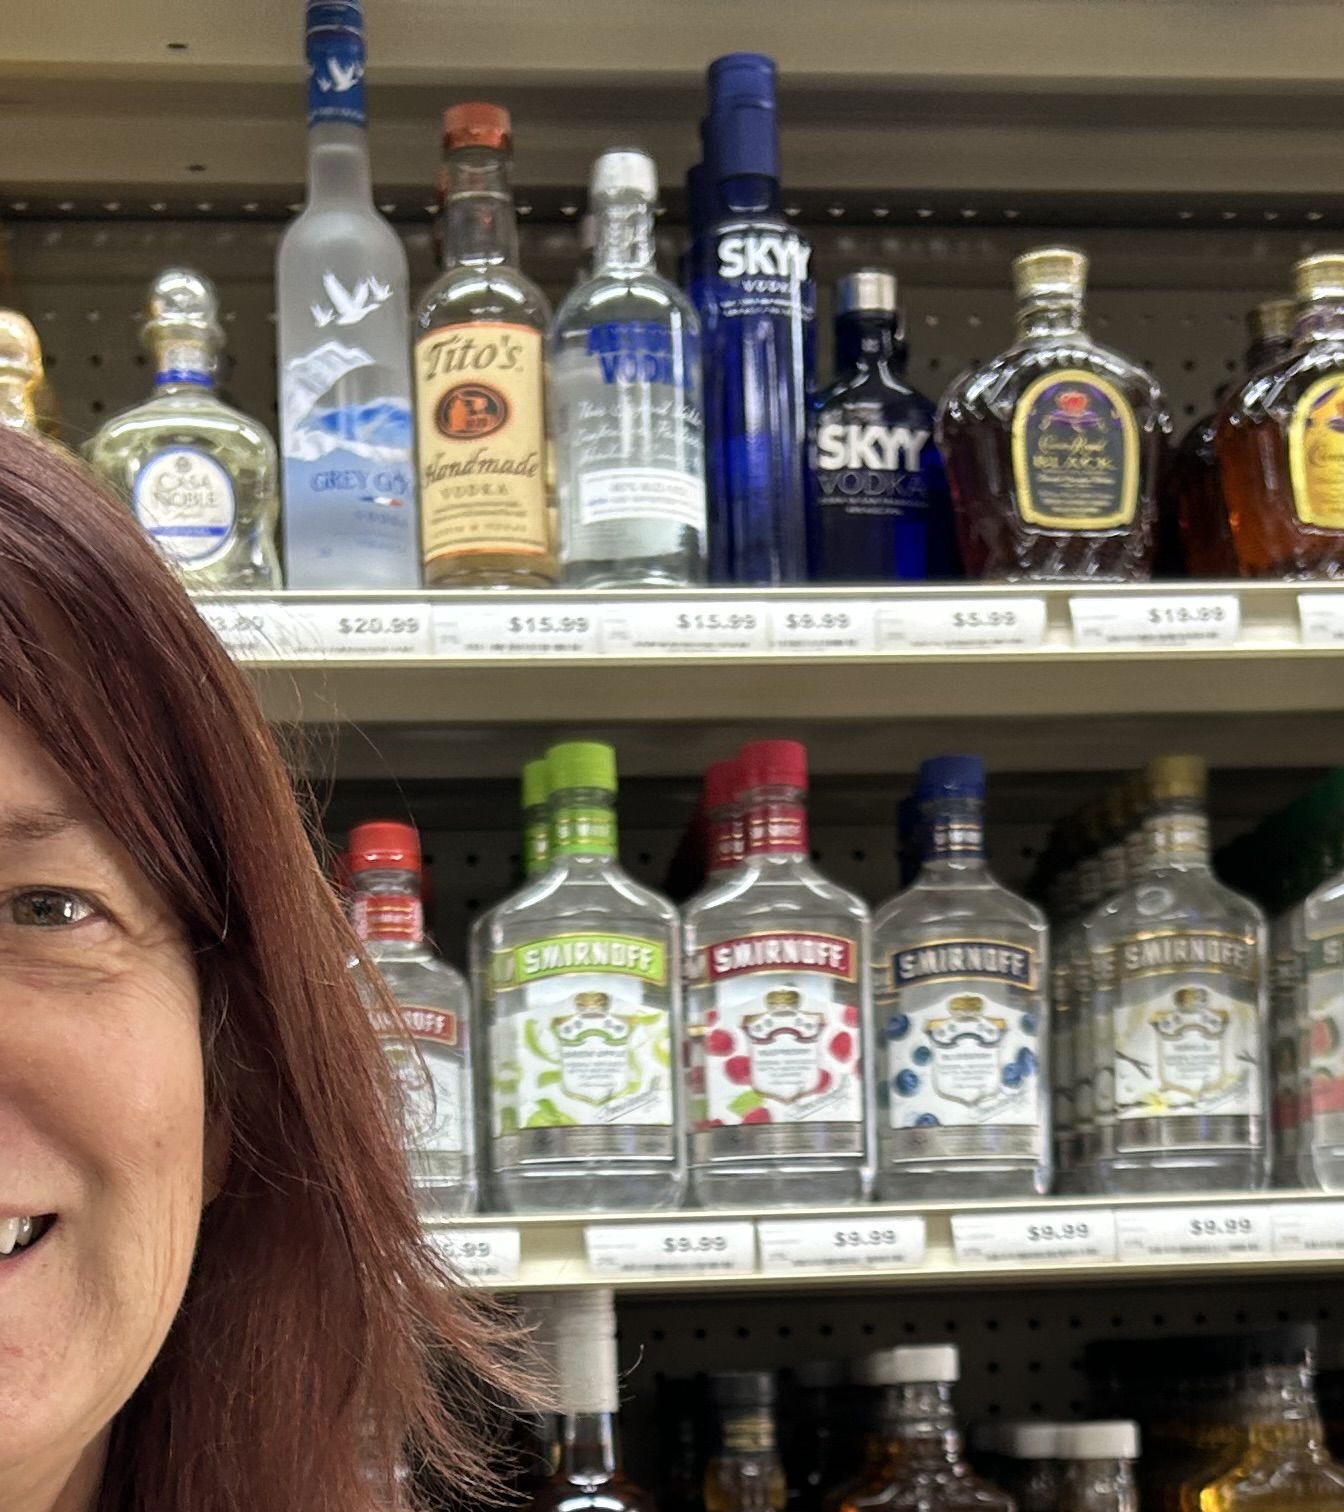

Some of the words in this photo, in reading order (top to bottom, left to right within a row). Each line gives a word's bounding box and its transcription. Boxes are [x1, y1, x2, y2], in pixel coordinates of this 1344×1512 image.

[718, 236, 812, 280] SKYY
[424, 334, 516, 380] Tito's
[818, 423, 931, 471] SKYY
[426, 450, 537, 488] Handmade
[338, 617, 420, 634] $20.99
[508, 617, 589, 633] $15.99
[525, 941, 653, 974] SMIRNOFF
[714, 938, 844, 974] SMIRNOFF
[899, 947, 1025, 980] SMIRNOFF
[1125, 938, 1250, 971] SMIRNOFF
[833, 1230, 897, 1248] $9.99
[1027, 1222, 1090, 1241] $9.99
[1190, 1218, 1253, 1236] $9.99
[662, 1236, 728, 1253] $9.99
